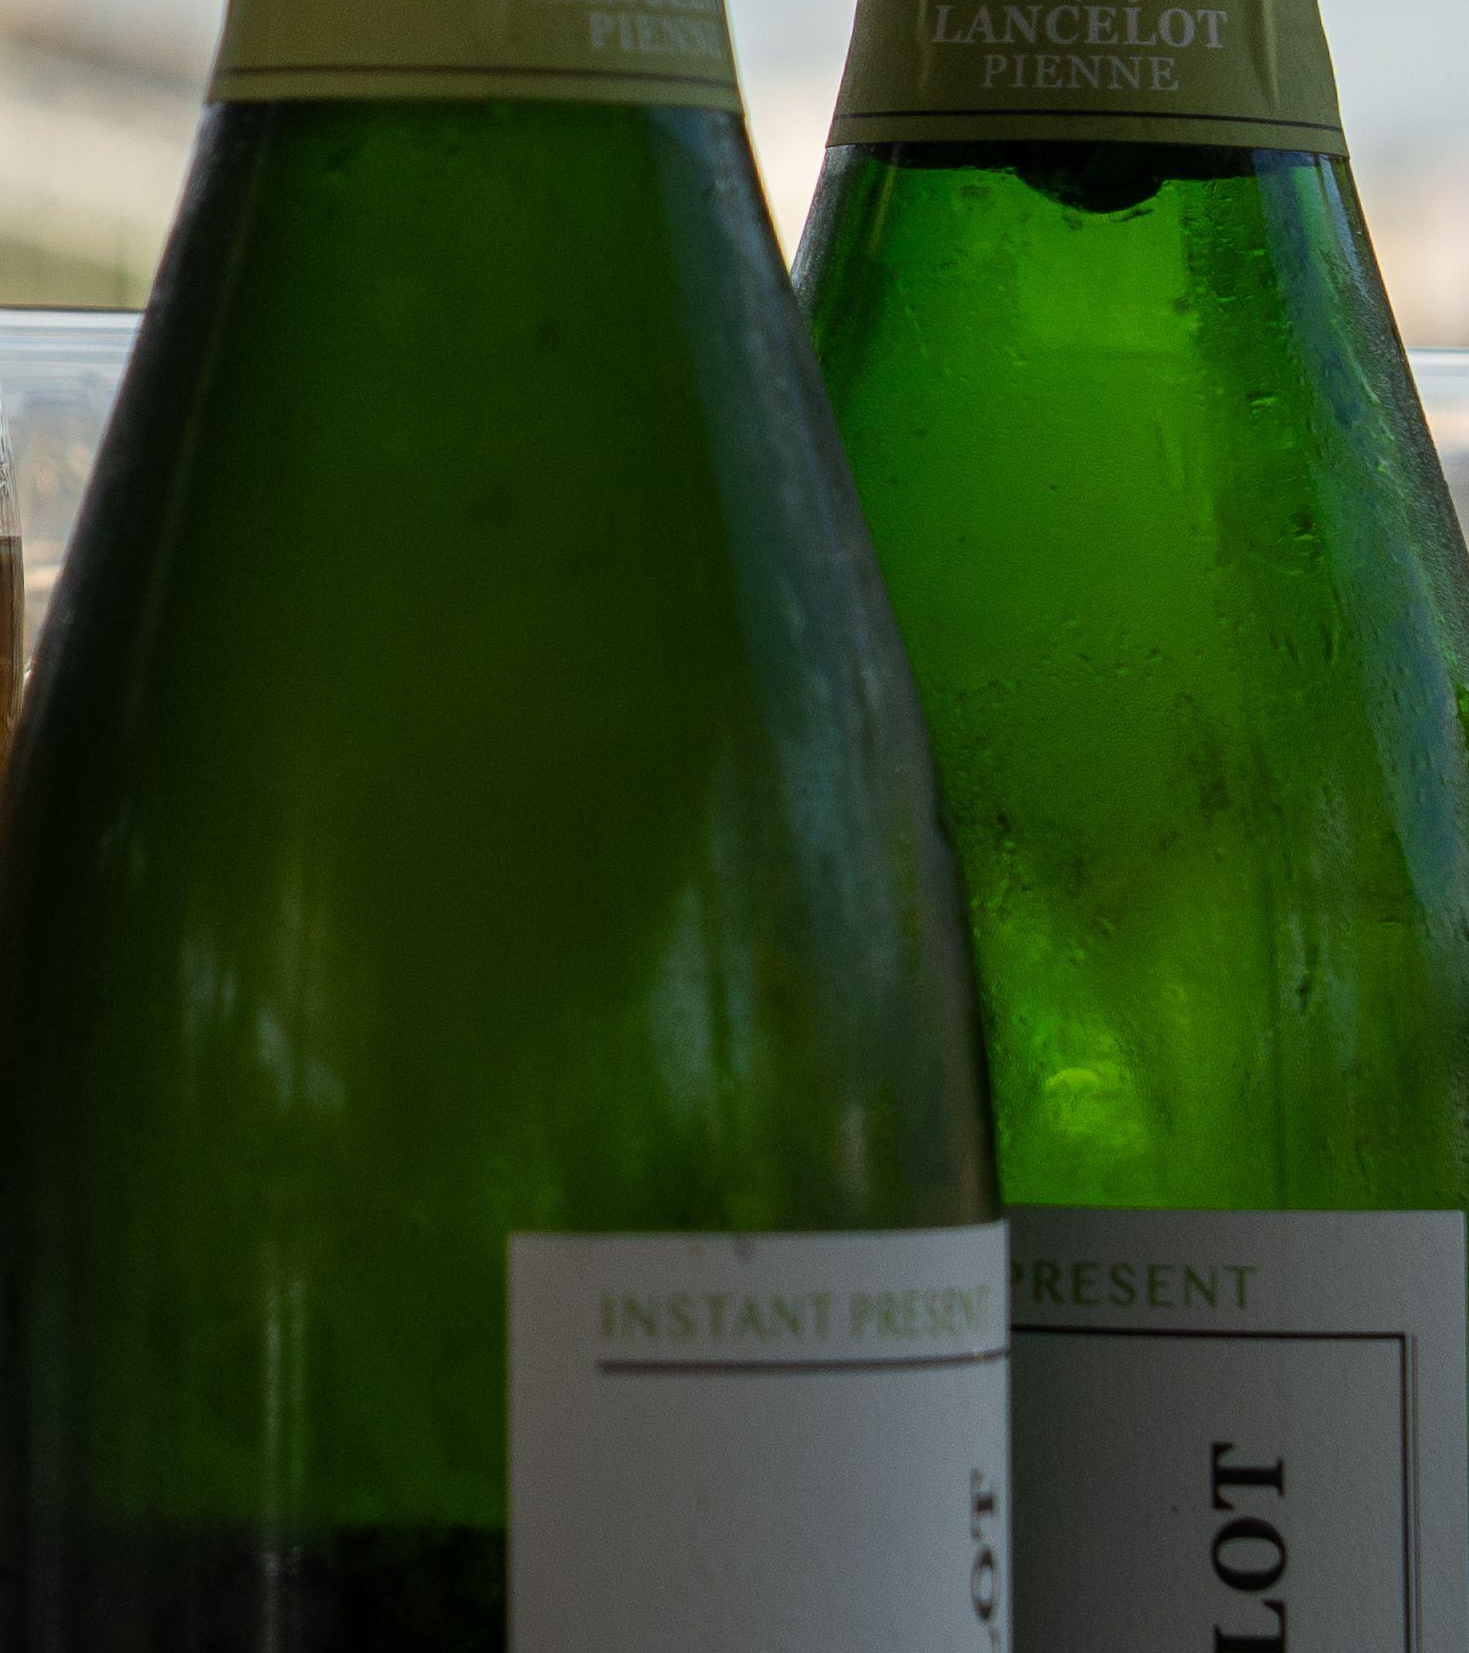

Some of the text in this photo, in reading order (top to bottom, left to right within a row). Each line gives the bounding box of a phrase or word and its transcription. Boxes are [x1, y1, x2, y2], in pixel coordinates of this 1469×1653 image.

[931, 4, 1228, 49] LANCELOT
[980, 54, 1180, 93] PIENNE
[598, 1283, 991, 1344] INSTANT PRESENT
